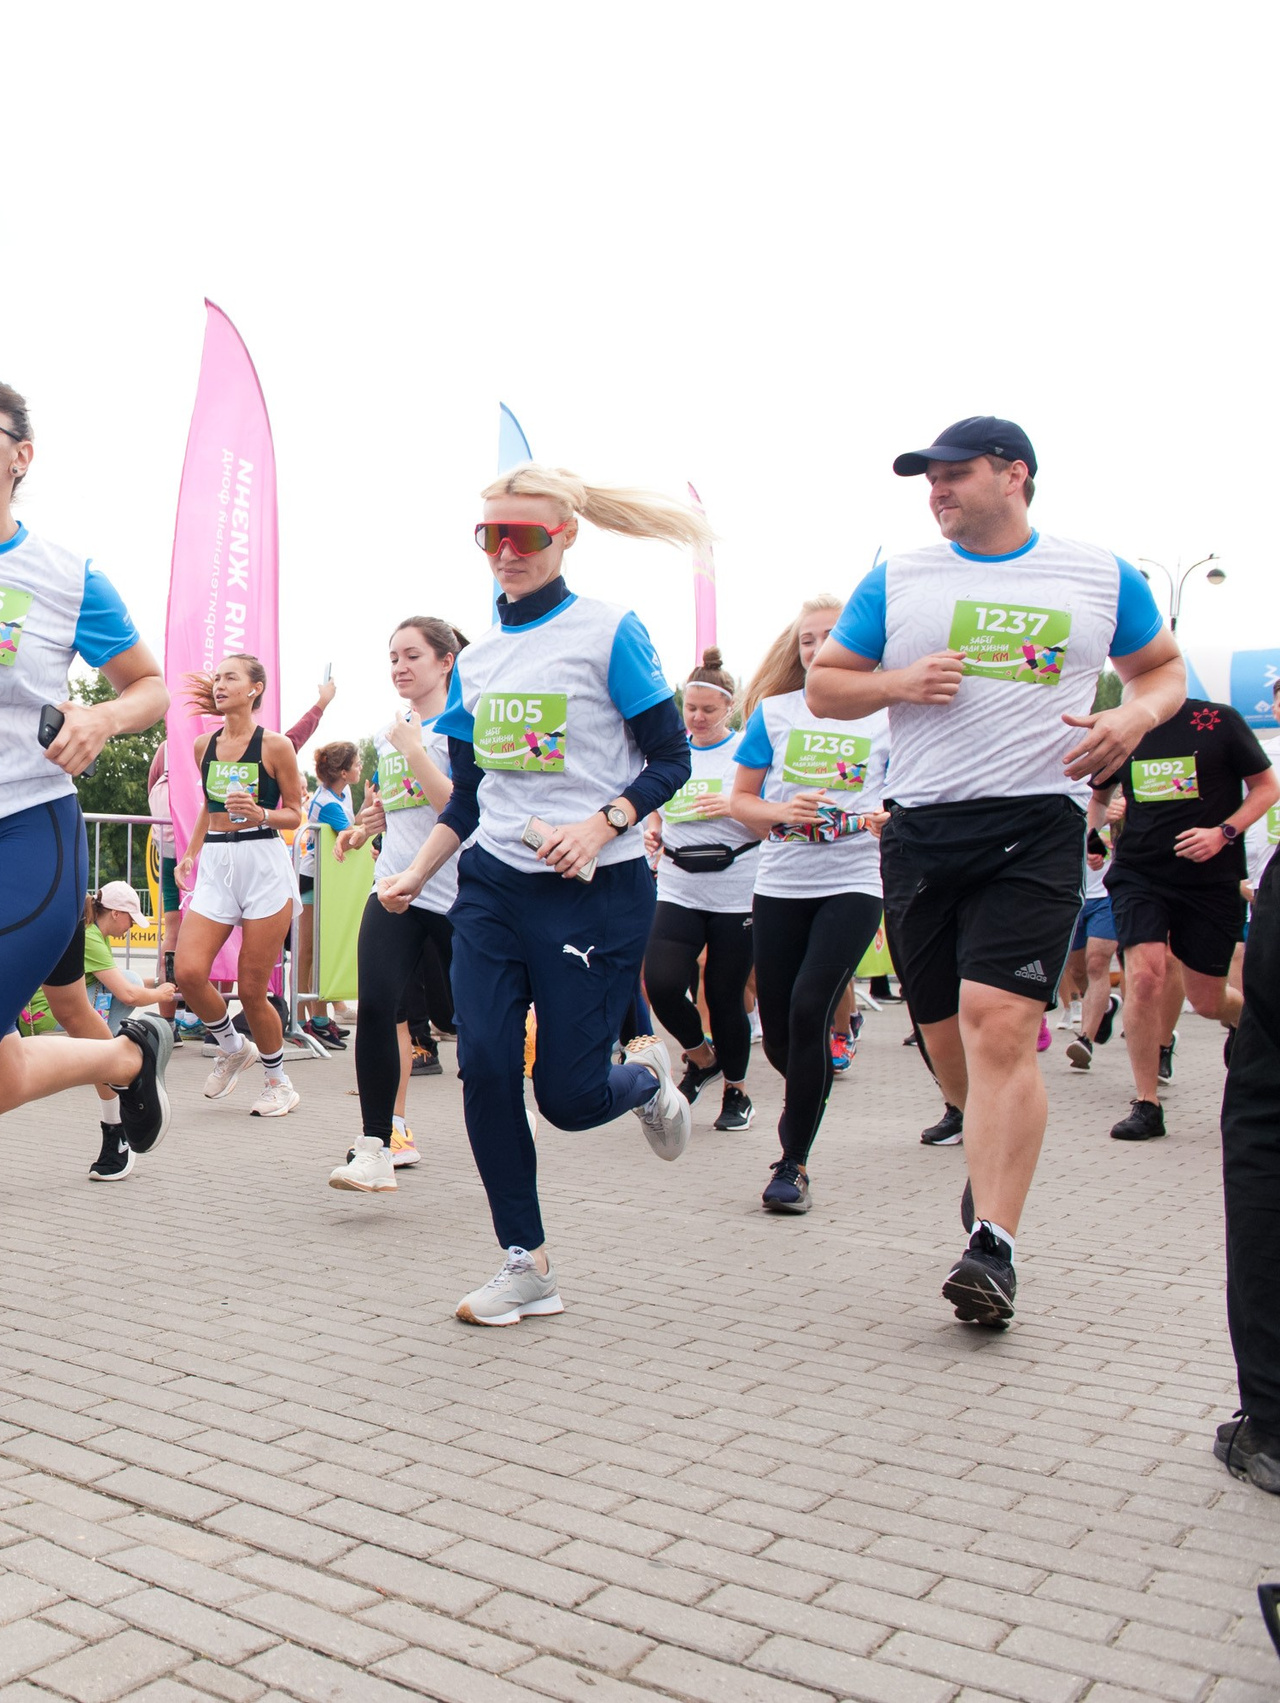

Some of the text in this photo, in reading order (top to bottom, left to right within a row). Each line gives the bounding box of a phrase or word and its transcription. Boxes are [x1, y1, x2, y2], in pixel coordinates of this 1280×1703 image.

[975, 607, 1050, 637] 1237
[960, 644, 1010, 652] РАДИ ЖИЗНИ
[969, 635, 995, 645] ЗАБЕГ
[488, 698, 543, 724] 1105
[803, 734, 856, 757] 1236
[215, 764, 249, 780] 1466
[1141, 760, 1185, 777] 1092
[1014, 970, 1047, 983] adidas
